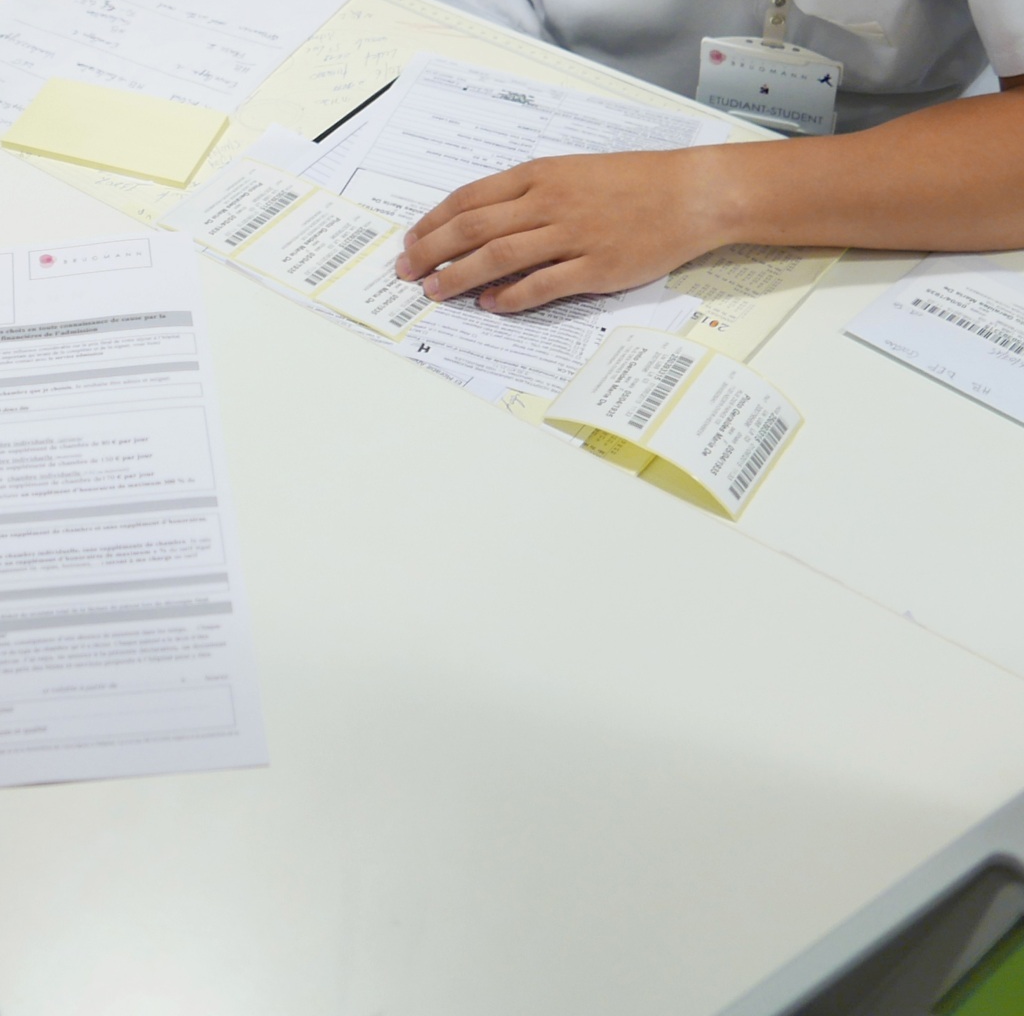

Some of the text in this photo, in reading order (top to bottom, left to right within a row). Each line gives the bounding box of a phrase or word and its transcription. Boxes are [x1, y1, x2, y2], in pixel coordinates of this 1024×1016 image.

[730, 61, 808, 80] BRUGMANN
[708, 94, 824, 124] ETUDIANT-STUDENT
[212, 207, 226, 220] Maria
[326, 216, 340, 229] Pinto
[304, 226, 327, 247] Geraldes
[290, 244, 305, 257] Maria
[372, 286, 387, 298] Maria
[956, 291, 977, 304] Maria
[690, 311, 730, 332] 2015
[633, 346, 647, 362] Pinto
[615, 359, 636, 384] Geraldes
[603, 383, 617, 399] Maria
[605, 388, 631, 418] 05/04/1935
[701, 393, 750, 457] Pinto Geraldes Maria De
[709, 444, 735, 475] 05/04/1935
